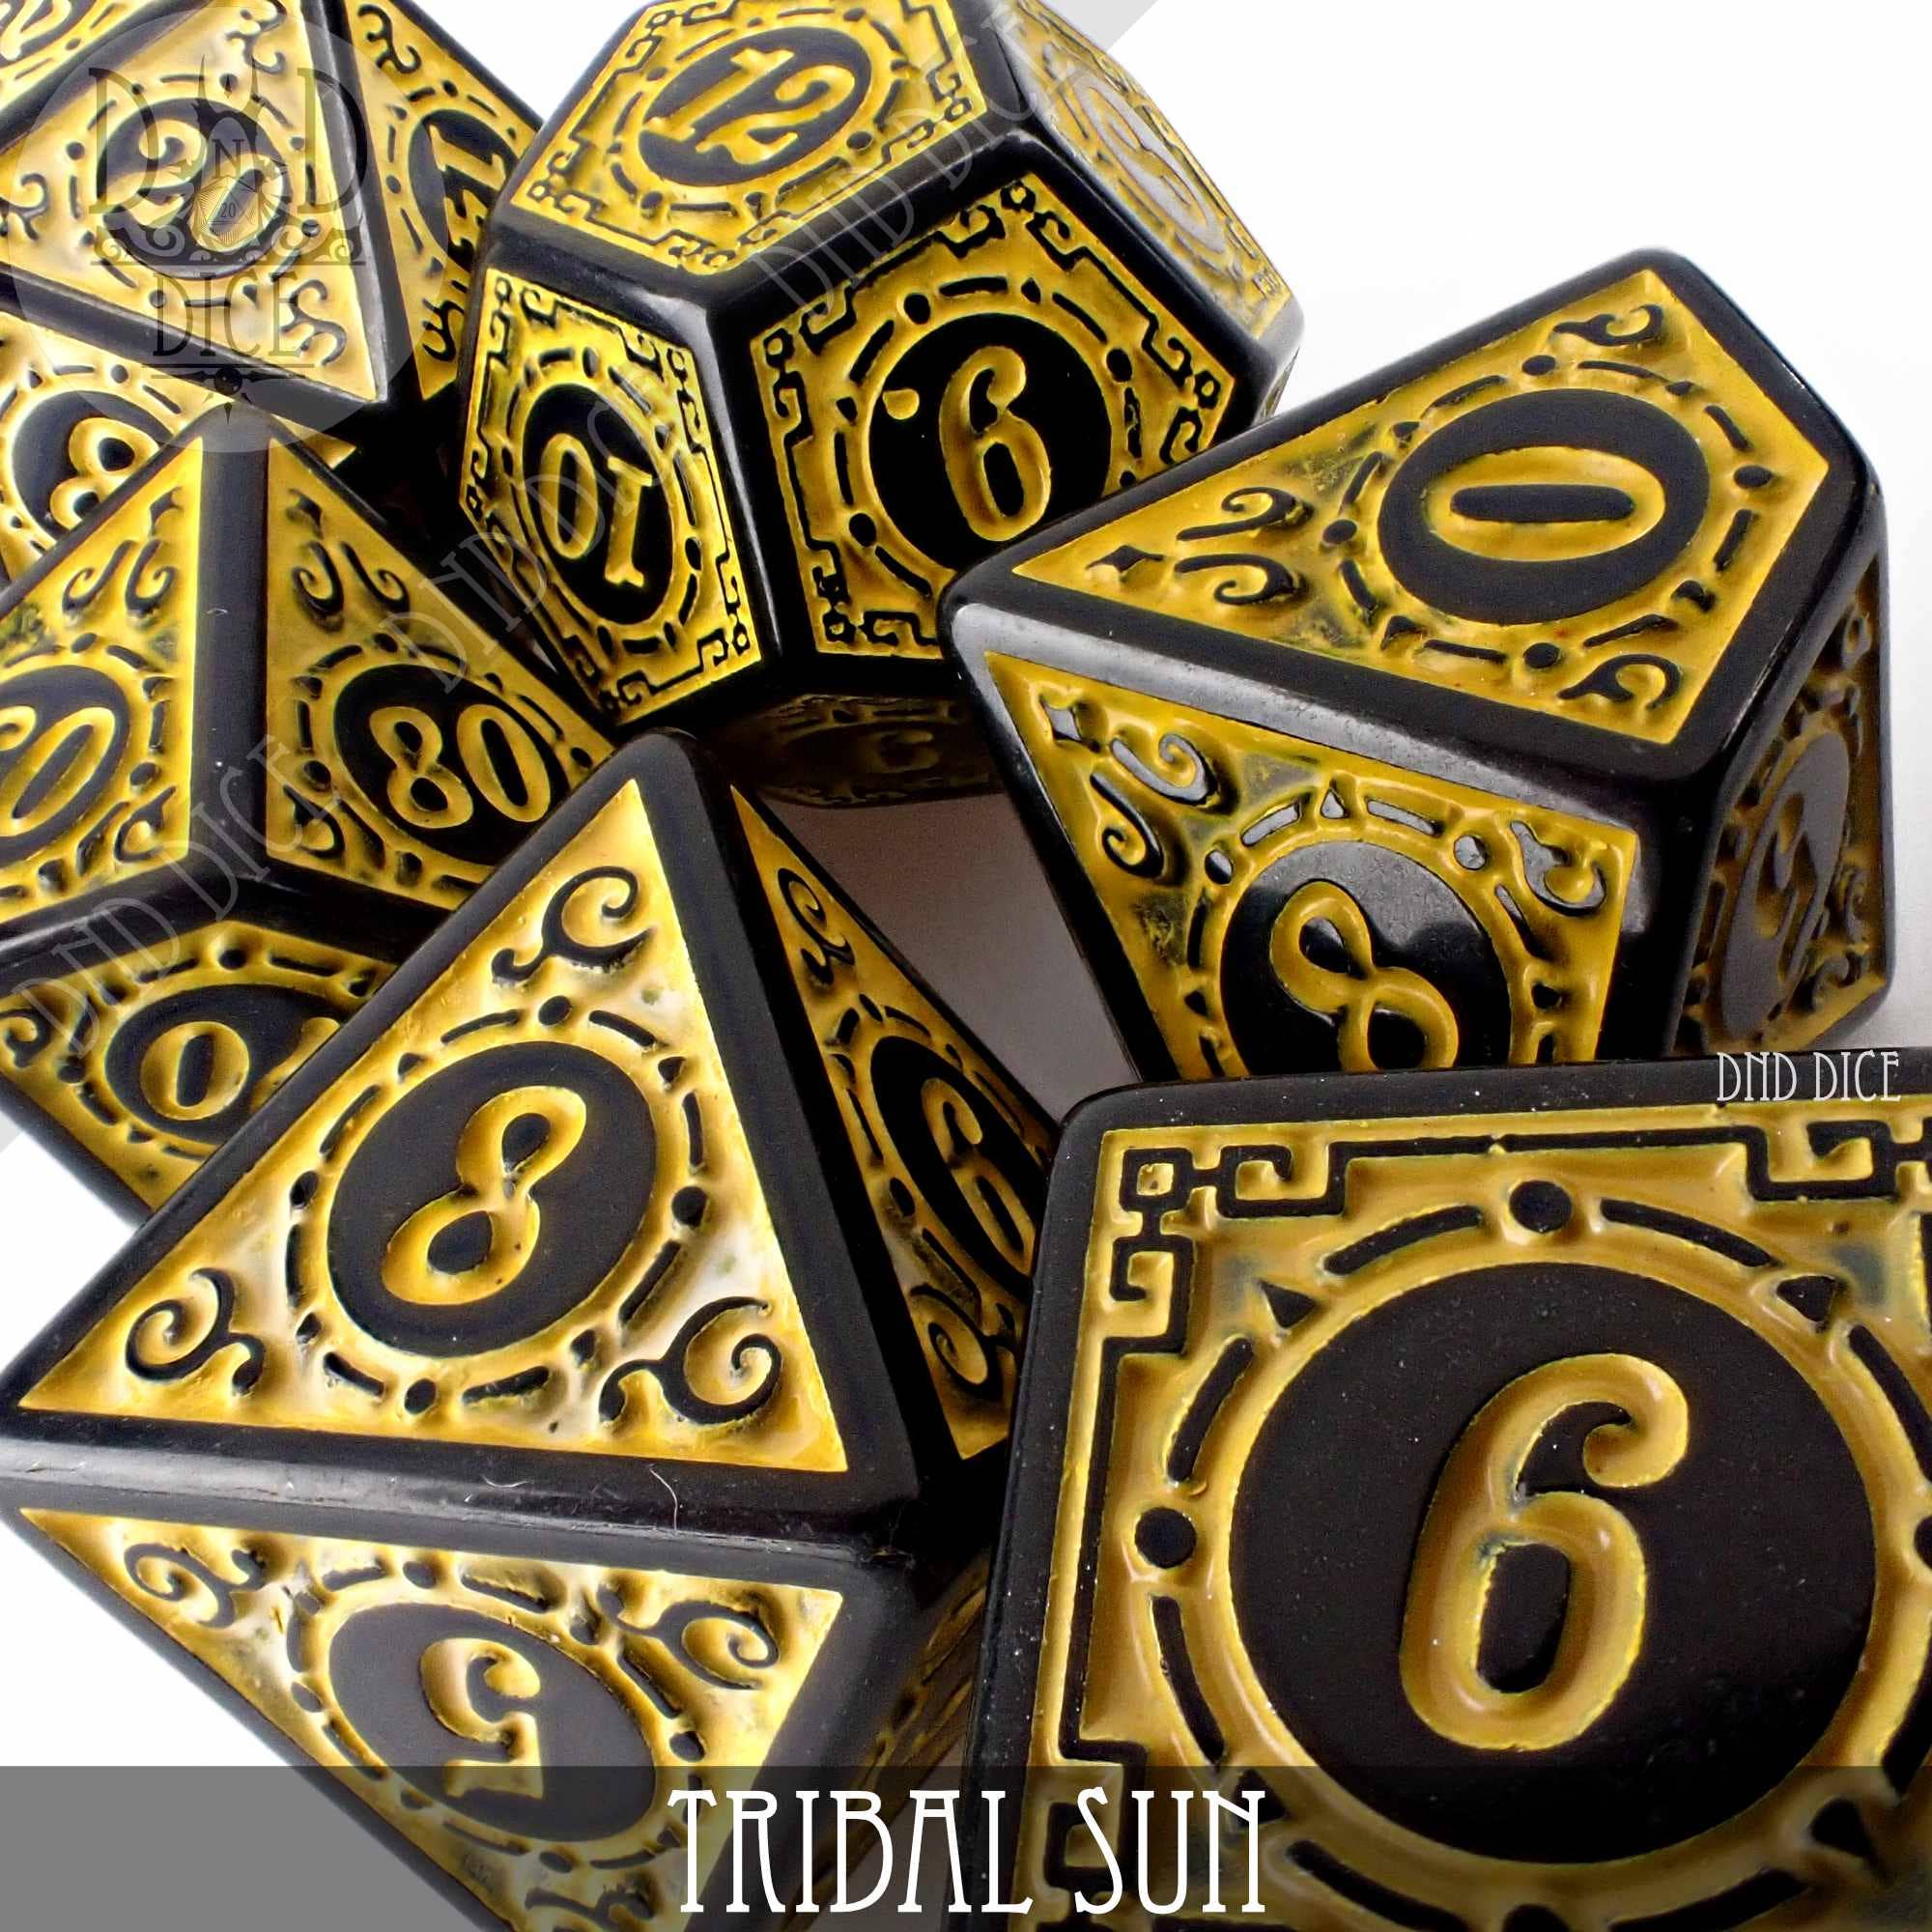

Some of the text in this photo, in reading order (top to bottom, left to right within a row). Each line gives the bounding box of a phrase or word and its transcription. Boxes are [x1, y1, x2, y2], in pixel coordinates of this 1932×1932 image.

[99, 117, 284, 252] 20
[638, 46, 856, 165] 12
[537, 431, 653, 589] 10
[1424, 445, 1666, 562] 0
[370, 704, 551, 829] 80
[1268, 879, 1458, 1072] 8
[381, 1085, 587, 1305] 8
[920, 1076, 1037, 1276] 6
[1399, 1353, 1689, 1751] 6
[418, 1637, 544, 1800] 5
